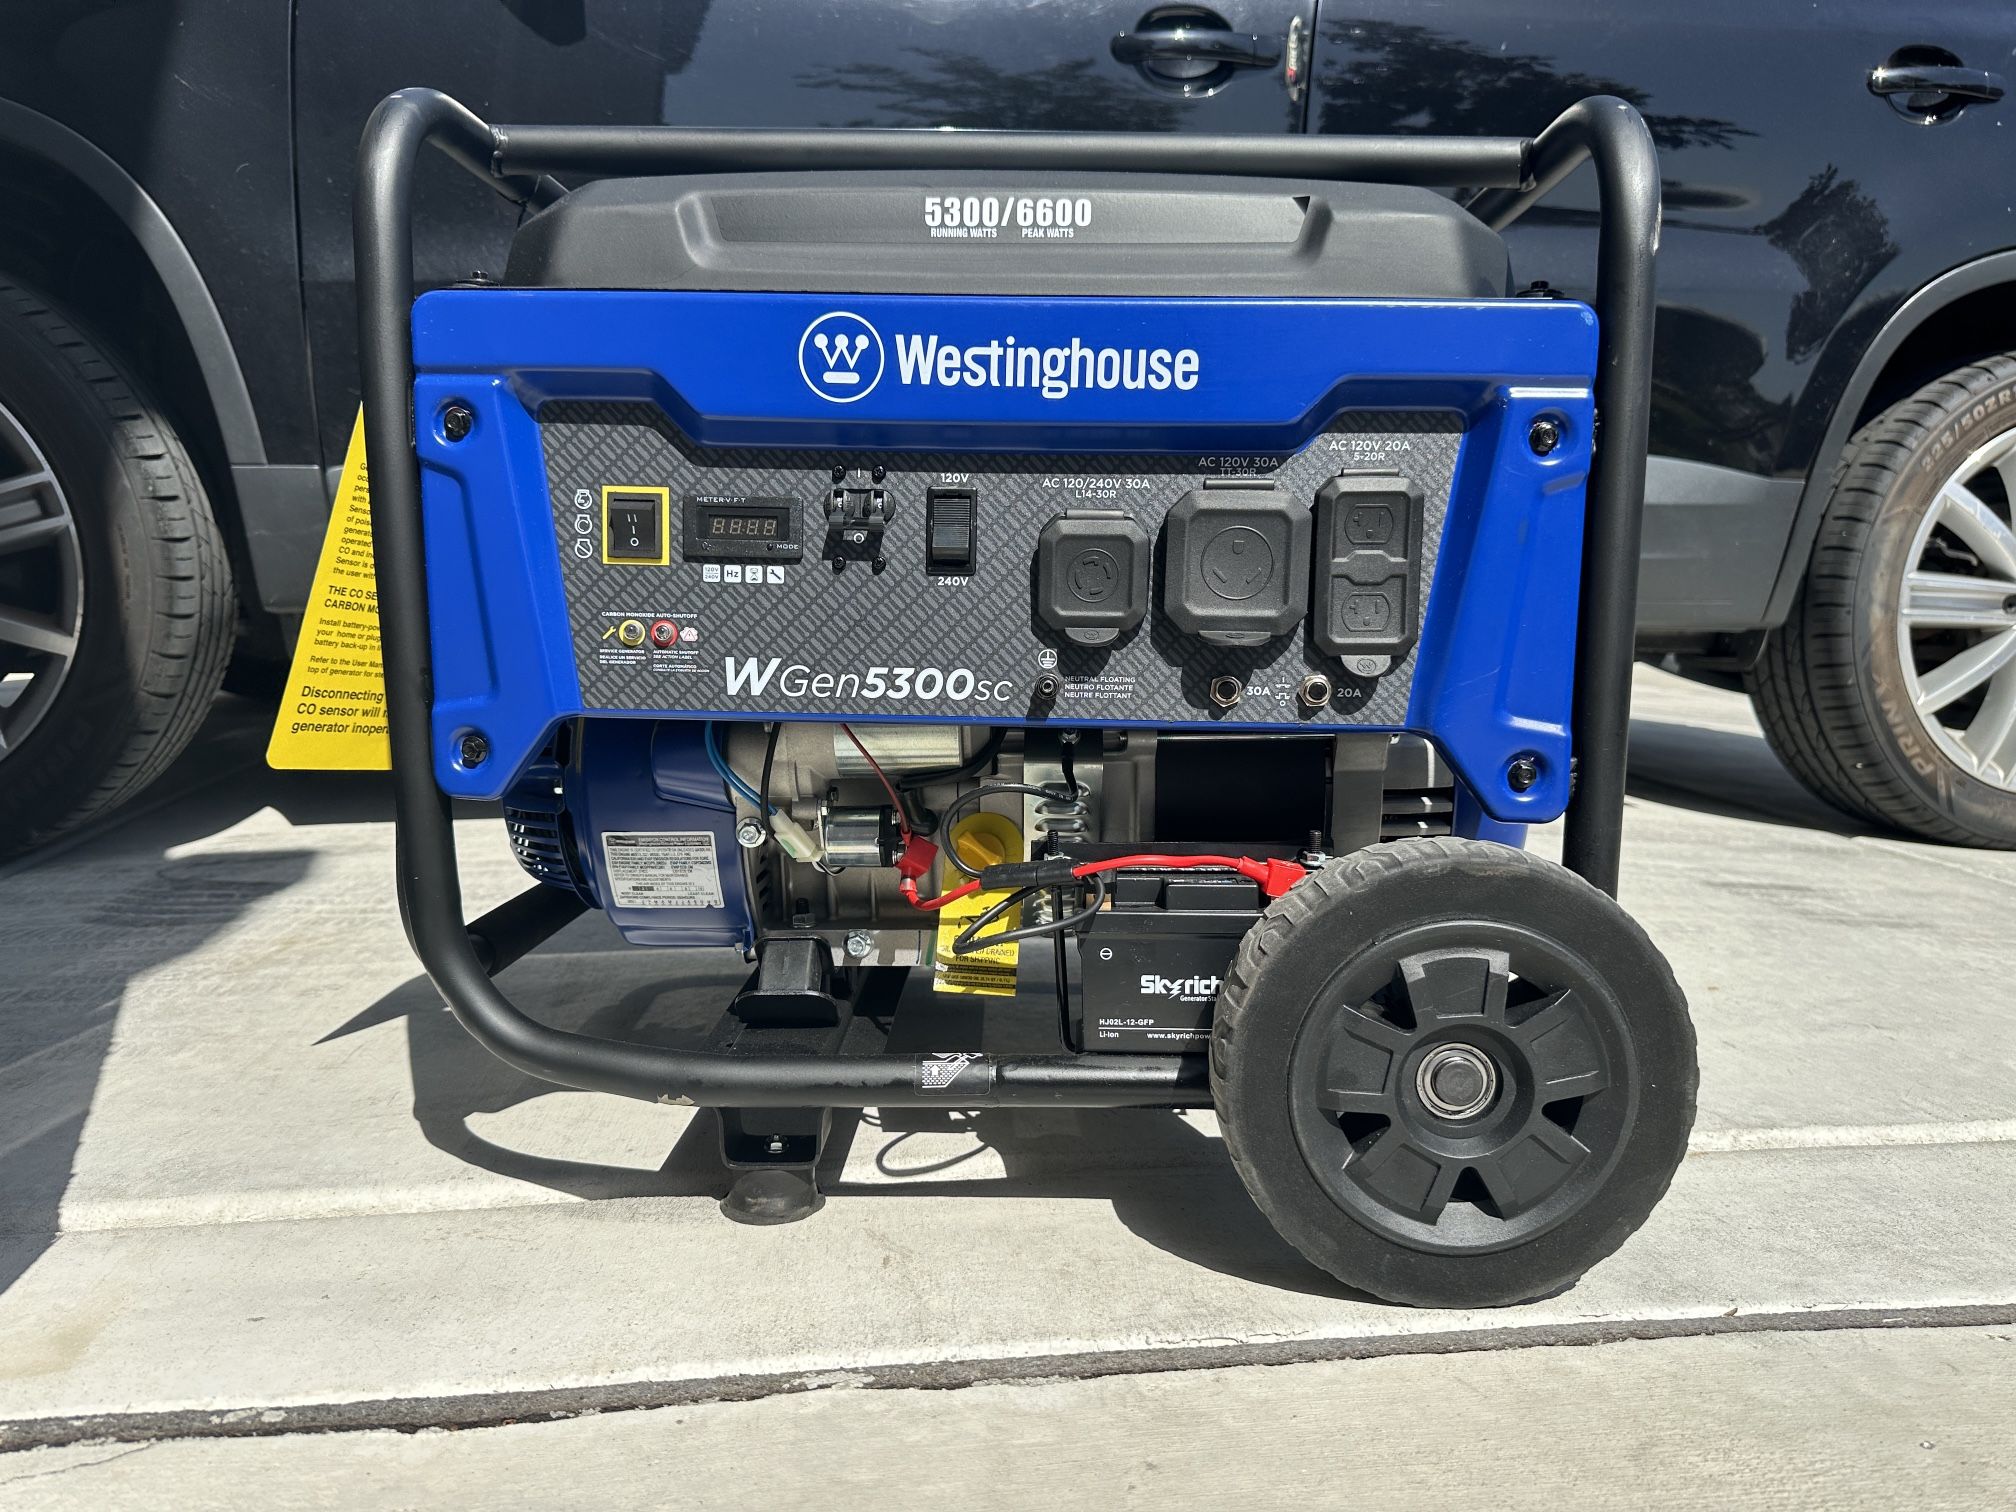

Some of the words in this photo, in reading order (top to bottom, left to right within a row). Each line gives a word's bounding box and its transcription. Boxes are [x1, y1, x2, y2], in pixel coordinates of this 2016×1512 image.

[925, 196, 1092, 227] 5300/6600
[931, 227, 968, 238] RUNNING
[970, 227, 997, 238] WATTS
[1021, 228, 1045, 238] PEAK
[1046, 228, 1074, 238] WATTS
[895, 334, 1200, 400] Westinghouse
[1329, 441, 1347, 450] AC
[1351, 441, 1382, 451] 120V
[1384, 441, 1411, 451] 20A
[1198, 457, 1217, 467] AC
[1219, 457, 1249, 467] 120V
[1253, 457, 1279, 468] 30A
[1353, 453, 1385, 461] 5-20R
[941, 473, 969, 483] 120V
[1042, 478, 1060, 488] AC
[1064, 478, 1121, 489] 120/240V
[1125, 479, 1150, 489] 30A
[1075, 490, 1117, 499] L14-30R
[338, 546, 351, 554] CO
[351, 549, 365, 557] and
[336, 556, 361, 567] Sensor
[726, 570, 739, 578] Hz
[937, 576, 969, 586] 240V
[328, 585, 348, 597] THE
[349, 588, 364, 599] CO
[324, 598, 366, 612] CARBON
[319, 617, 341, 627] Install
[316, 629, 334, 637] your
[337, 630, 357, 639] home
[314, 638, 339, 648] battery
[340, 641, 368, 651] back-up
[309, 655, 329, 663] Refer
[352, 659, 368, 667] User
[307, 666, 320, 674] top
[329, 668, 363, 677] generator
[1065, 675, 1099, 683] NEUTRAL
[301, 685, 384, 704] Disconnecting
[1246, 686, 1271, 696] 30A
[1337, 688, 1362, 698] 20A
[296, 702, 317, 715] CO
[319, 706, 359, 717] sensor
[361, 706, 381, 718] will
[291, 722, 350, 734] generator
